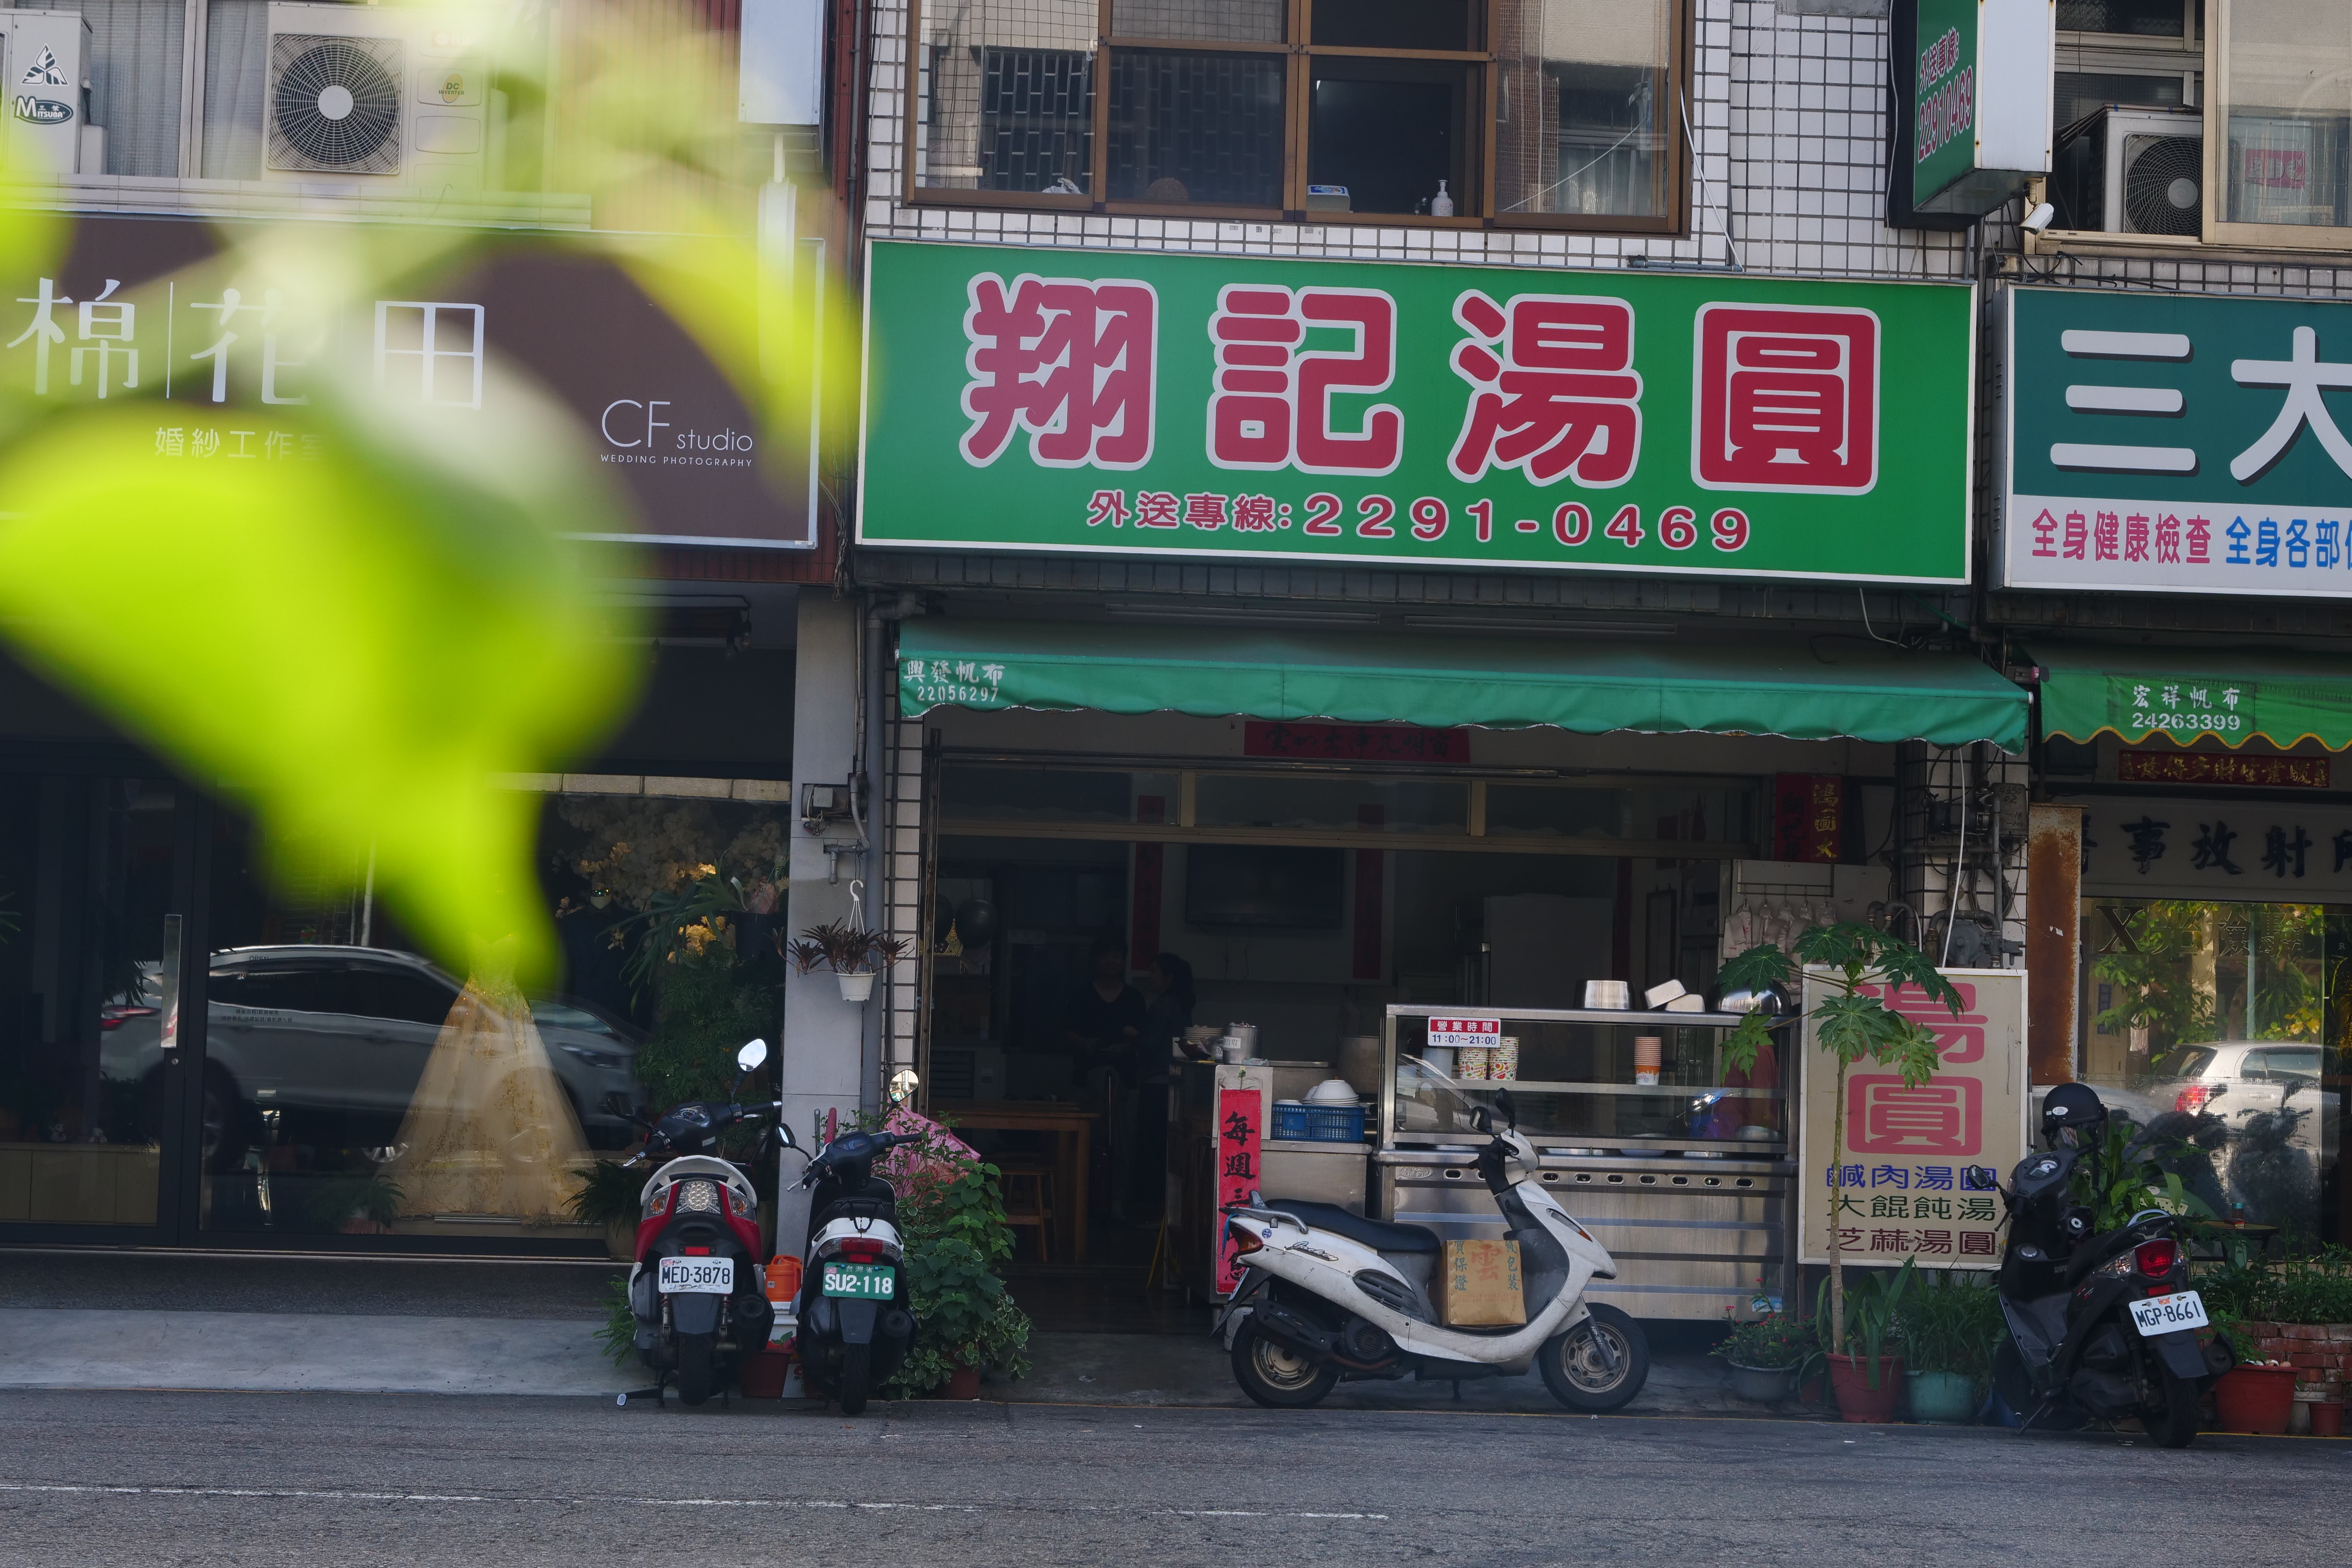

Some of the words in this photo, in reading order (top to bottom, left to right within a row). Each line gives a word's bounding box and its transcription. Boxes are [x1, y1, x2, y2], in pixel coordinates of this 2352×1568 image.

[1918, 65, 1973, 163] 22910469
[959, 272, 1881, 495] 翔記湯圓
[602, 399, 670, 448] CF
[677, 428, 753, 451] studio
[601, 454, 657, 464] WEDDING
[663, 456, 752, 467] PHOTOGRAPHY
[2032, 508, 2211, 564] 全身健康檢查
[2226, 515, 2352, 570] 全身各部
[918, 686, 998, 702] 22056297
[2132, 685, 2240, 710] 宏祥帆布
[2132, 713, 2240, 730] 24263399
[1437, 1020, 1492, 1032] 營業時間
[1222, 1111, 1256, 1280] 每週三息
[1827, 1194, 1996, 1221] 大餛飩湯
[825, 1273, 892, 1294] SU2-118
